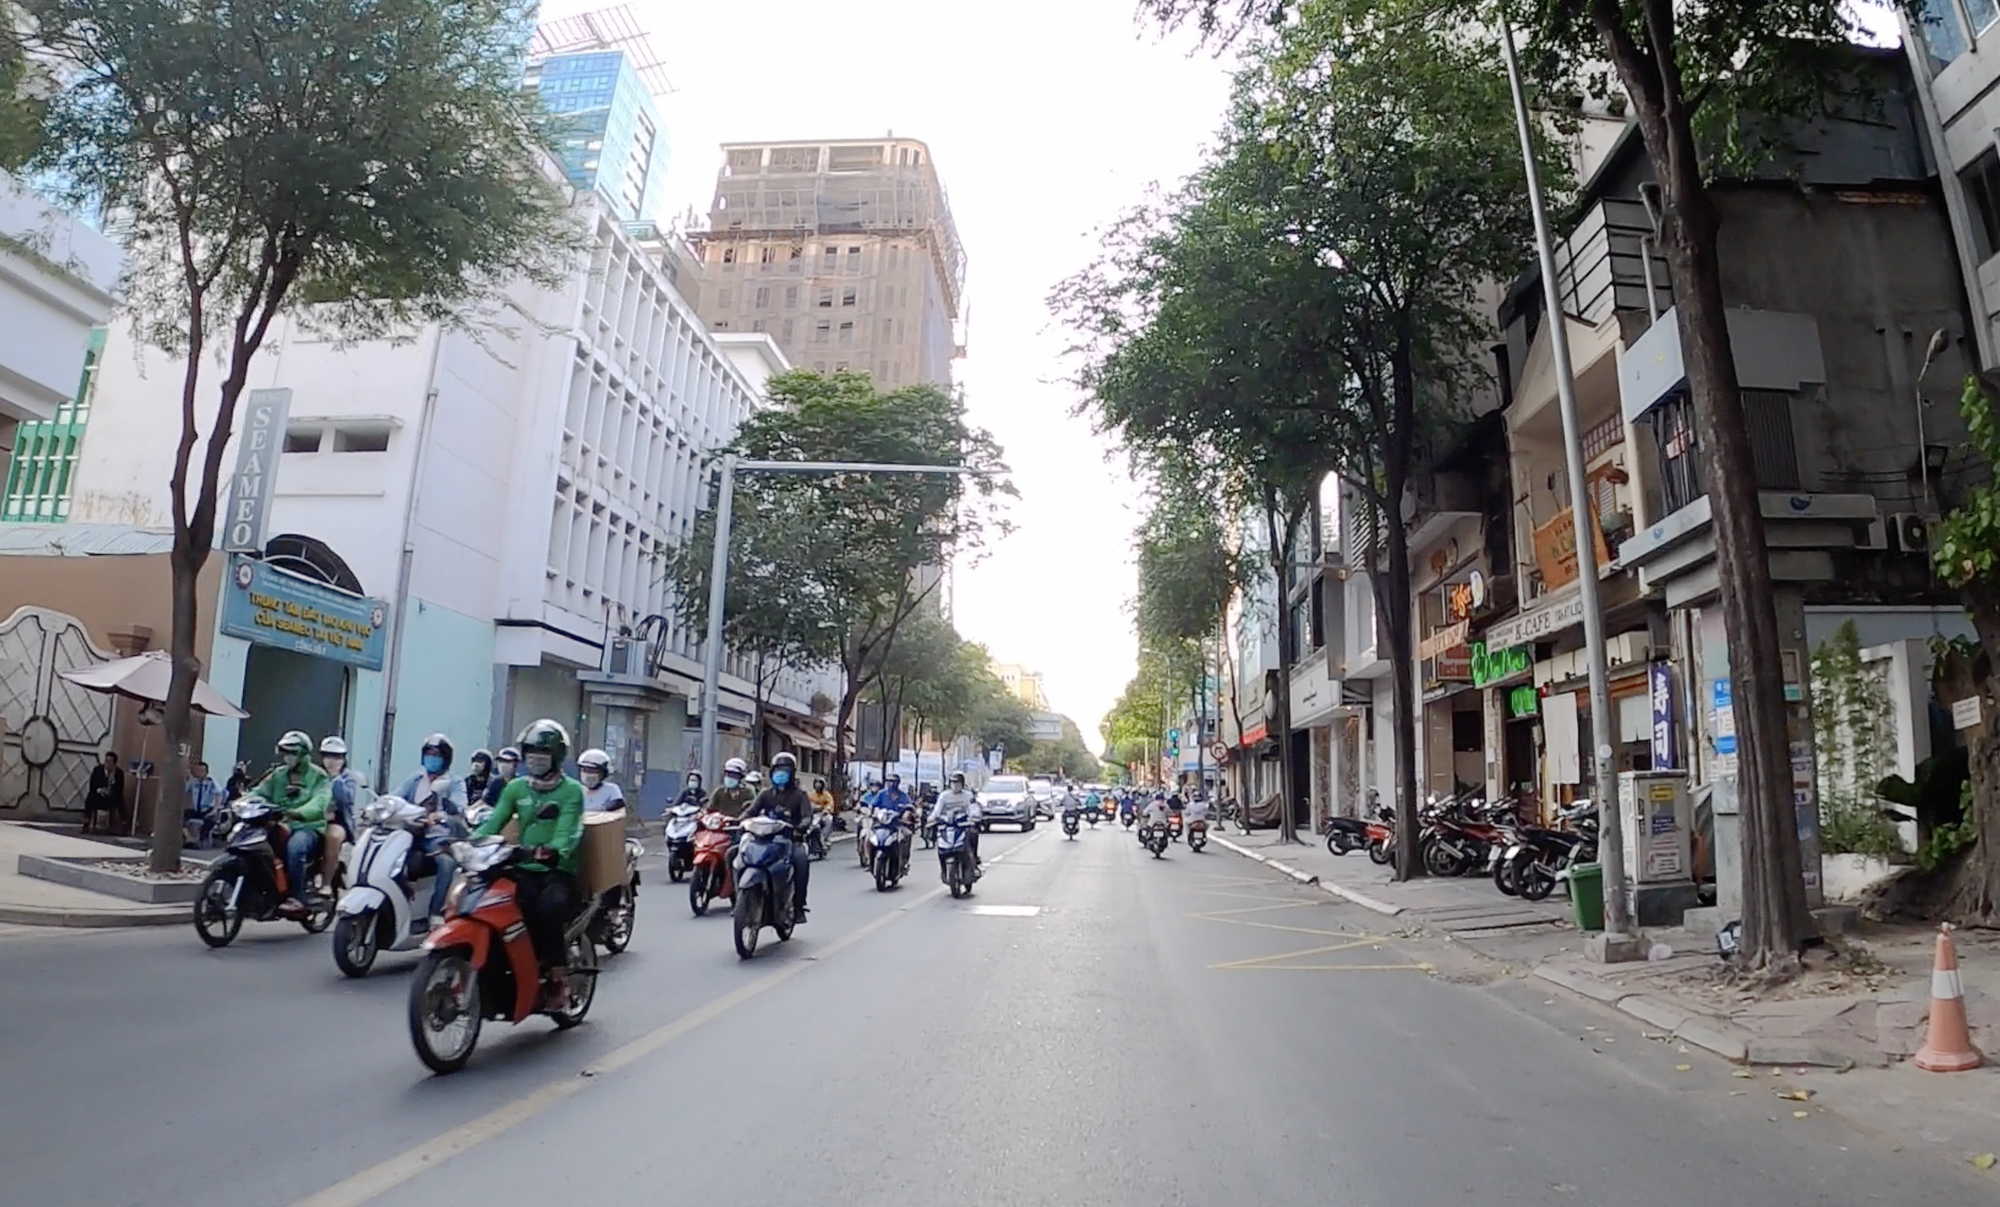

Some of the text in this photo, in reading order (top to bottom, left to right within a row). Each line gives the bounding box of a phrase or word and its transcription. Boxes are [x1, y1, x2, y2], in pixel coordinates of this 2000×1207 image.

[232, 406, 272, 546] SEAMEO
[249, 592, 281, 611] TRUNG
[1654, 672, 1670, 771] 寿司
